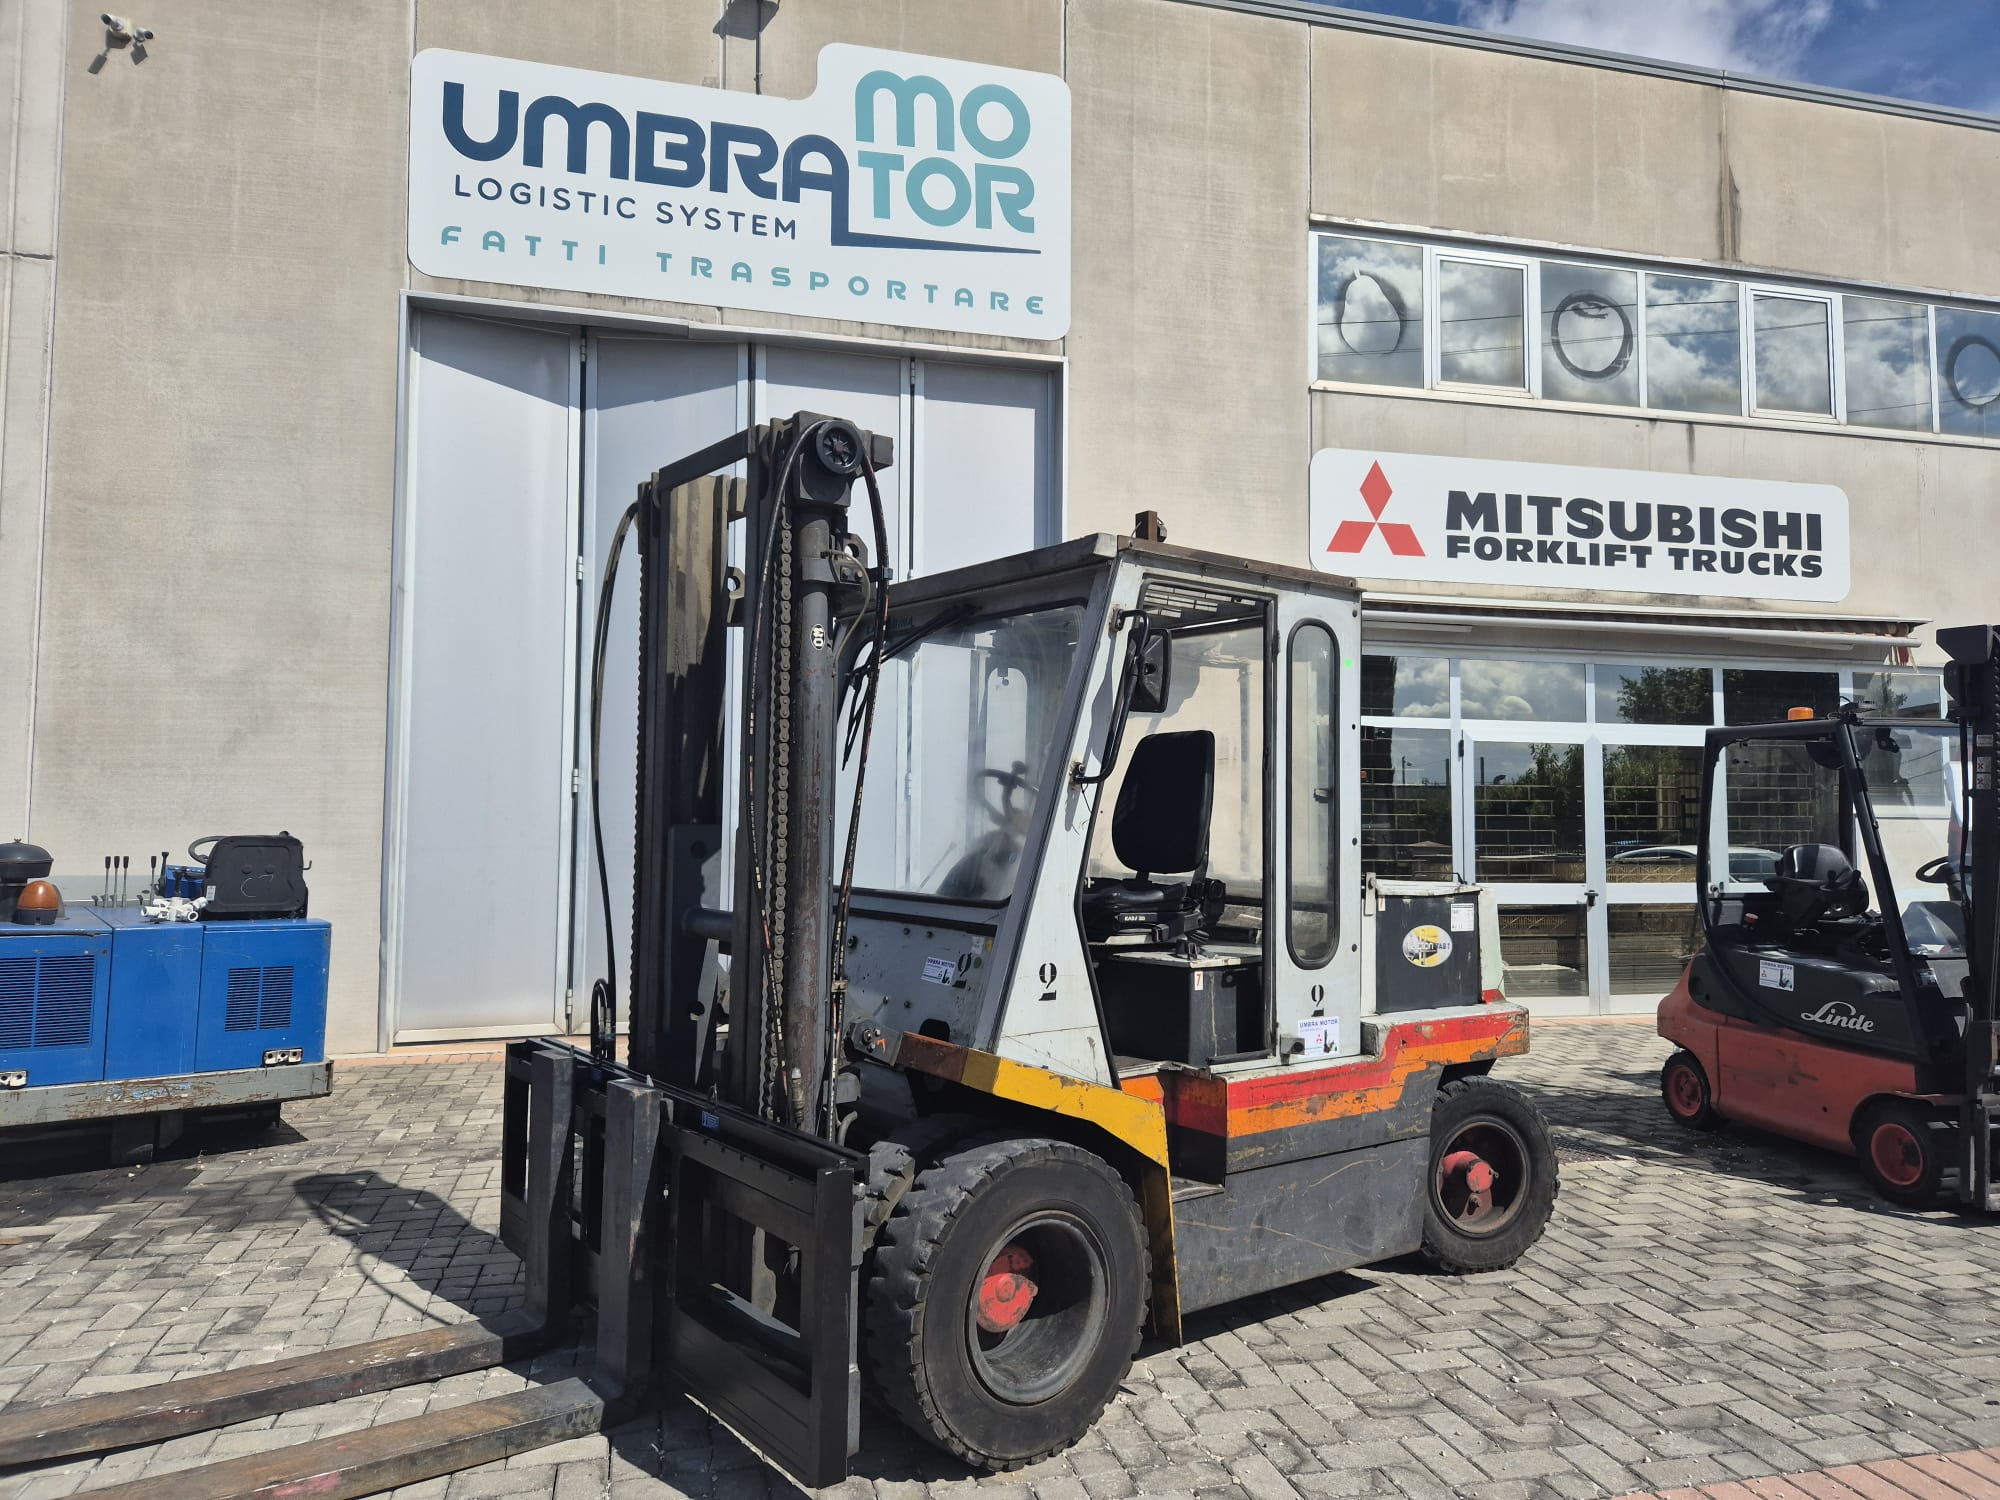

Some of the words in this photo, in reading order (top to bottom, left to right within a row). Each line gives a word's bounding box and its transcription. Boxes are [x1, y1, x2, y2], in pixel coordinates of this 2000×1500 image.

[855, 70, 1030, 159] MO
[443, 81, 850, 252] UMBRA
[858, 151, 1034, 233] TOR
[455, 174, 636, 219] LOGISTIC
[656, 202, 796, 240] SYSTEM
[441, 226, 606, 265] FATTI
[656, 252, 1044, 315] TRASPORTARE
[1446, 490, 1822, 551] MITSUBISHI
[1446, 535, 1653, 568] FORKLIFT
[1667, 548, 1823, 579] TRUCKS
[1320, 1018, 1338, 1026] MOTOR
[1801, 1001, 1874, 1033] Linde
